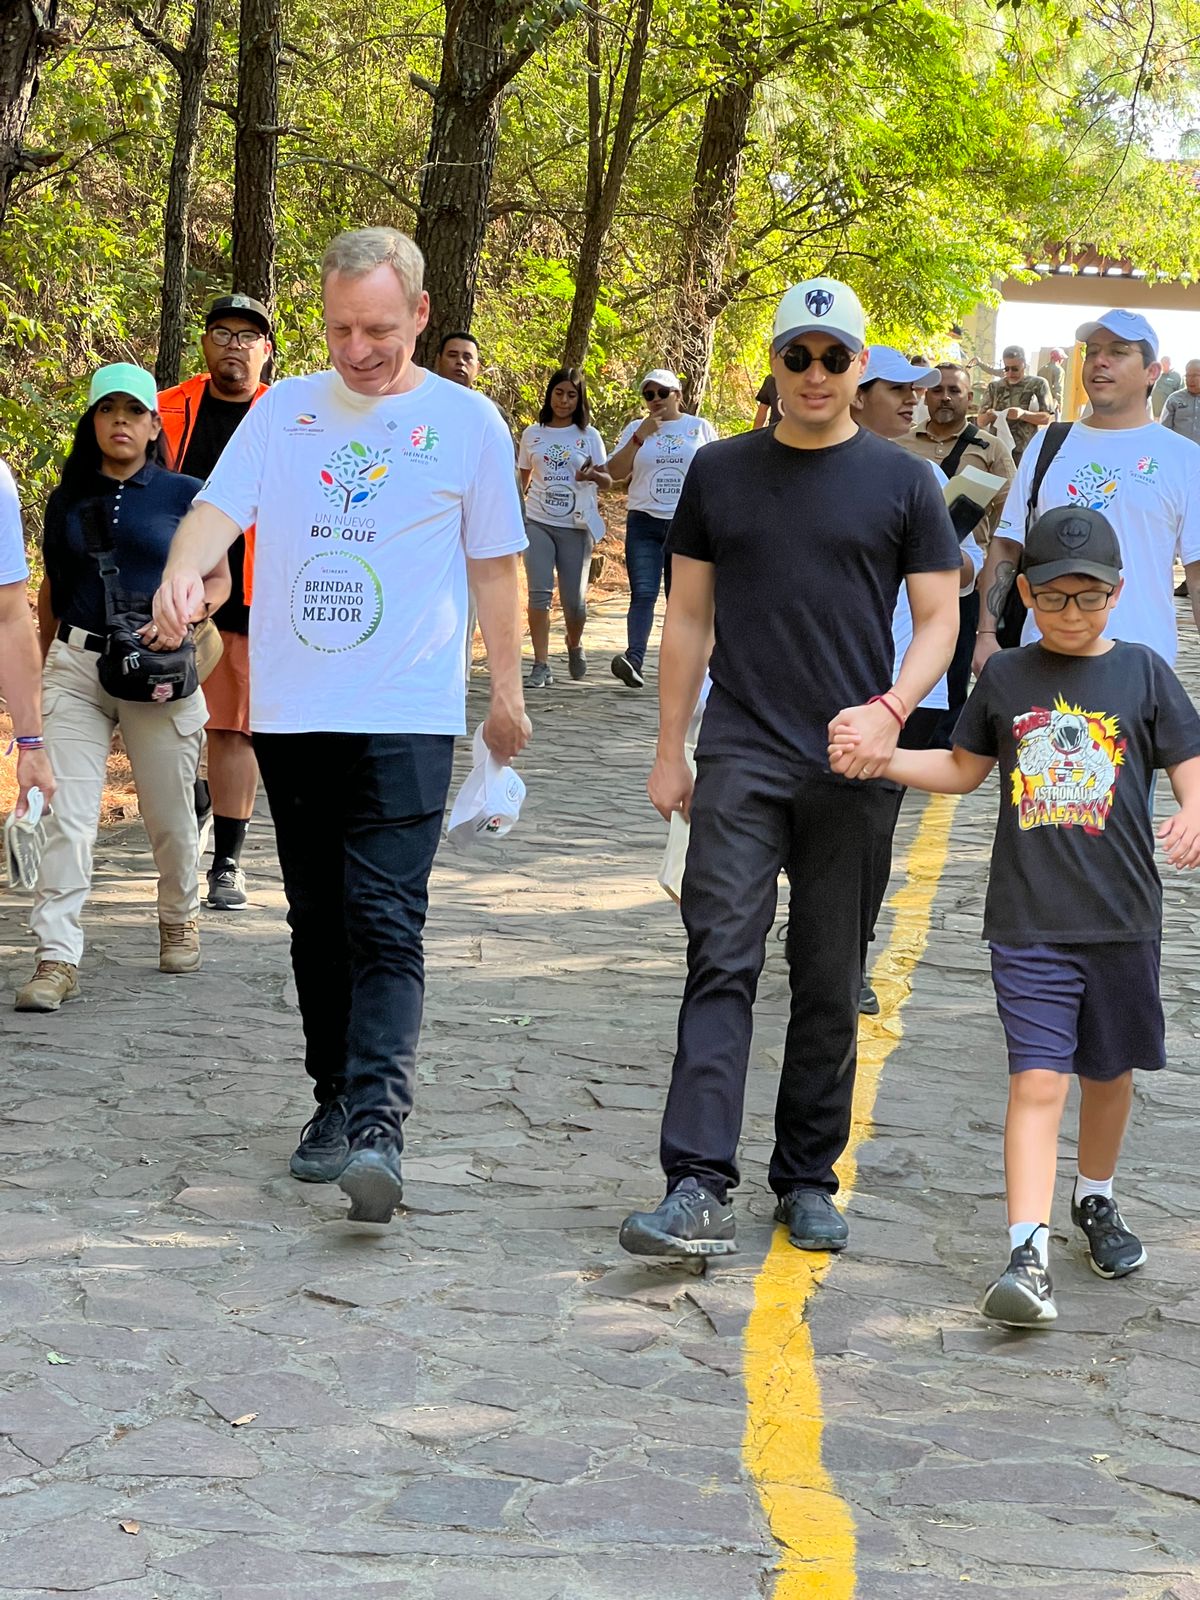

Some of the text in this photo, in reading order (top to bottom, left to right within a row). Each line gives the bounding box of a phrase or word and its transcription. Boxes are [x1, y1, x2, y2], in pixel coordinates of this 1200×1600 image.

[403, 450, 438, 463] HEINEKEN
[314, 513, 376, 529] UN NUEVO
[310, 525, 377, 543] BOSQUE
[304, 581, 364, 593] BRINDAR
[304, 595, 364, 605] UN MUNDO
[302, 606, 362, 622] MEJOR
[1034, 785, 1096, 801] ASTRONAUT
[1019, 795, 1110, 831] GALAXY
